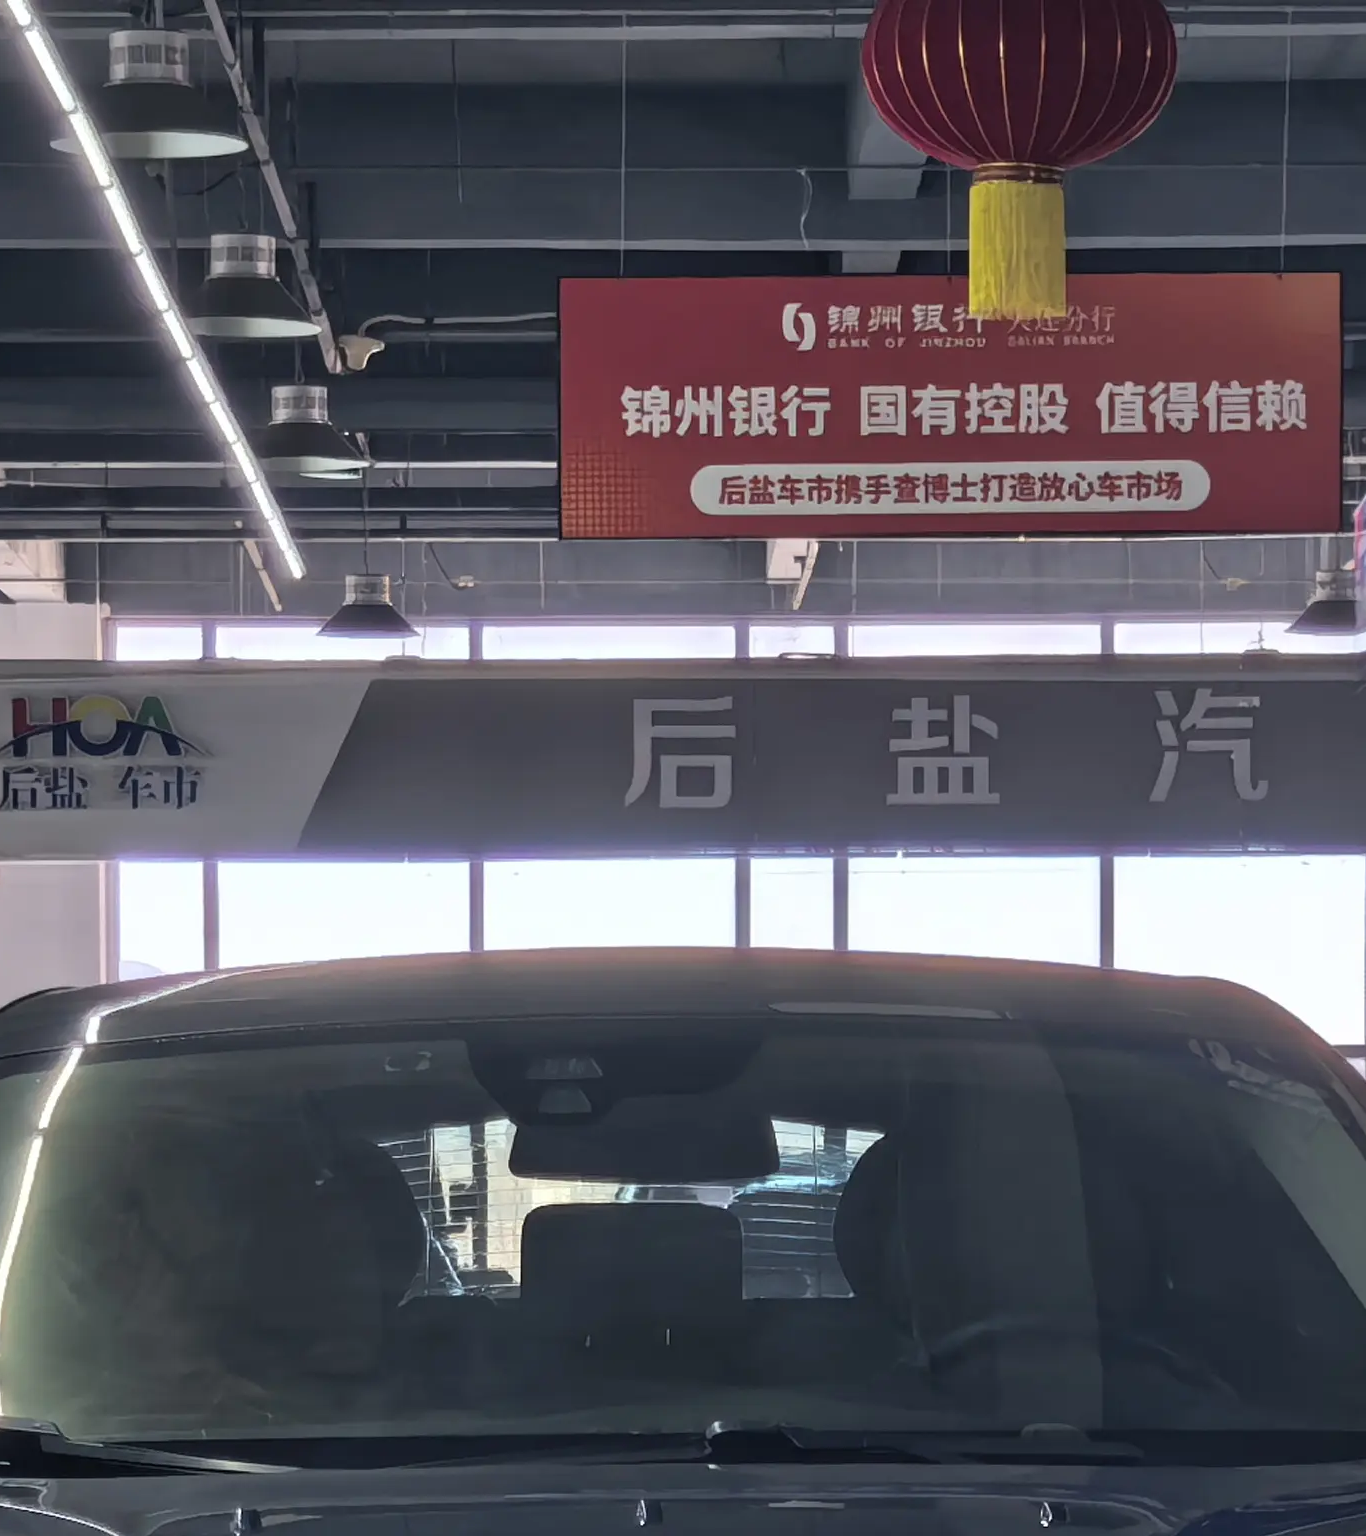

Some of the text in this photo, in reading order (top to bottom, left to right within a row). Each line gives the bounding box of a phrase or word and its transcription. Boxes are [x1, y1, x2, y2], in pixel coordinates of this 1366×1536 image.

[620, 380, 1308, 437] 锦州银行 国有控股 值得信赖
[718, 471, 1183, 505] 后盐车市携手查博士打造放心车市场
[11, 696, 184, 757] HOA
